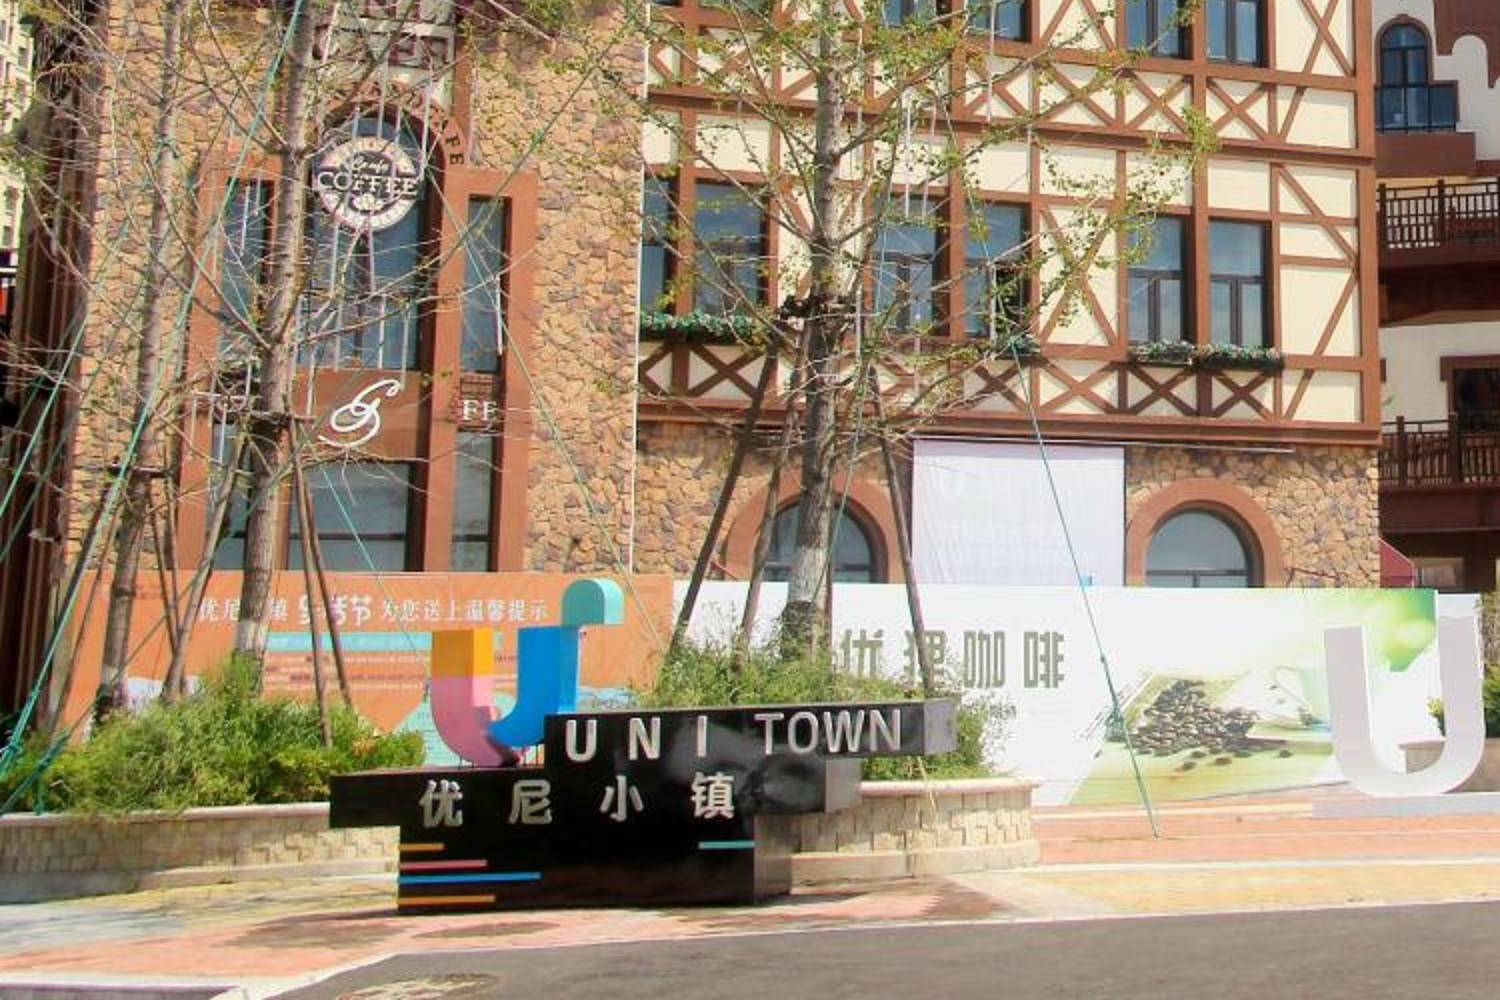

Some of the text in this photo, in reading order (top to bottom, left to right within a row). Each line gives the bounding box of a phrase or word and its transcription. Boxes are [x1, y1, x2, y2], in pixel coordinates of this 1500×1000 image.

[317, 171, 418, 196] COFFEE
[755, 708, 902, 754] TOWN
[418, 770, 735, 828] 优尼小镇
